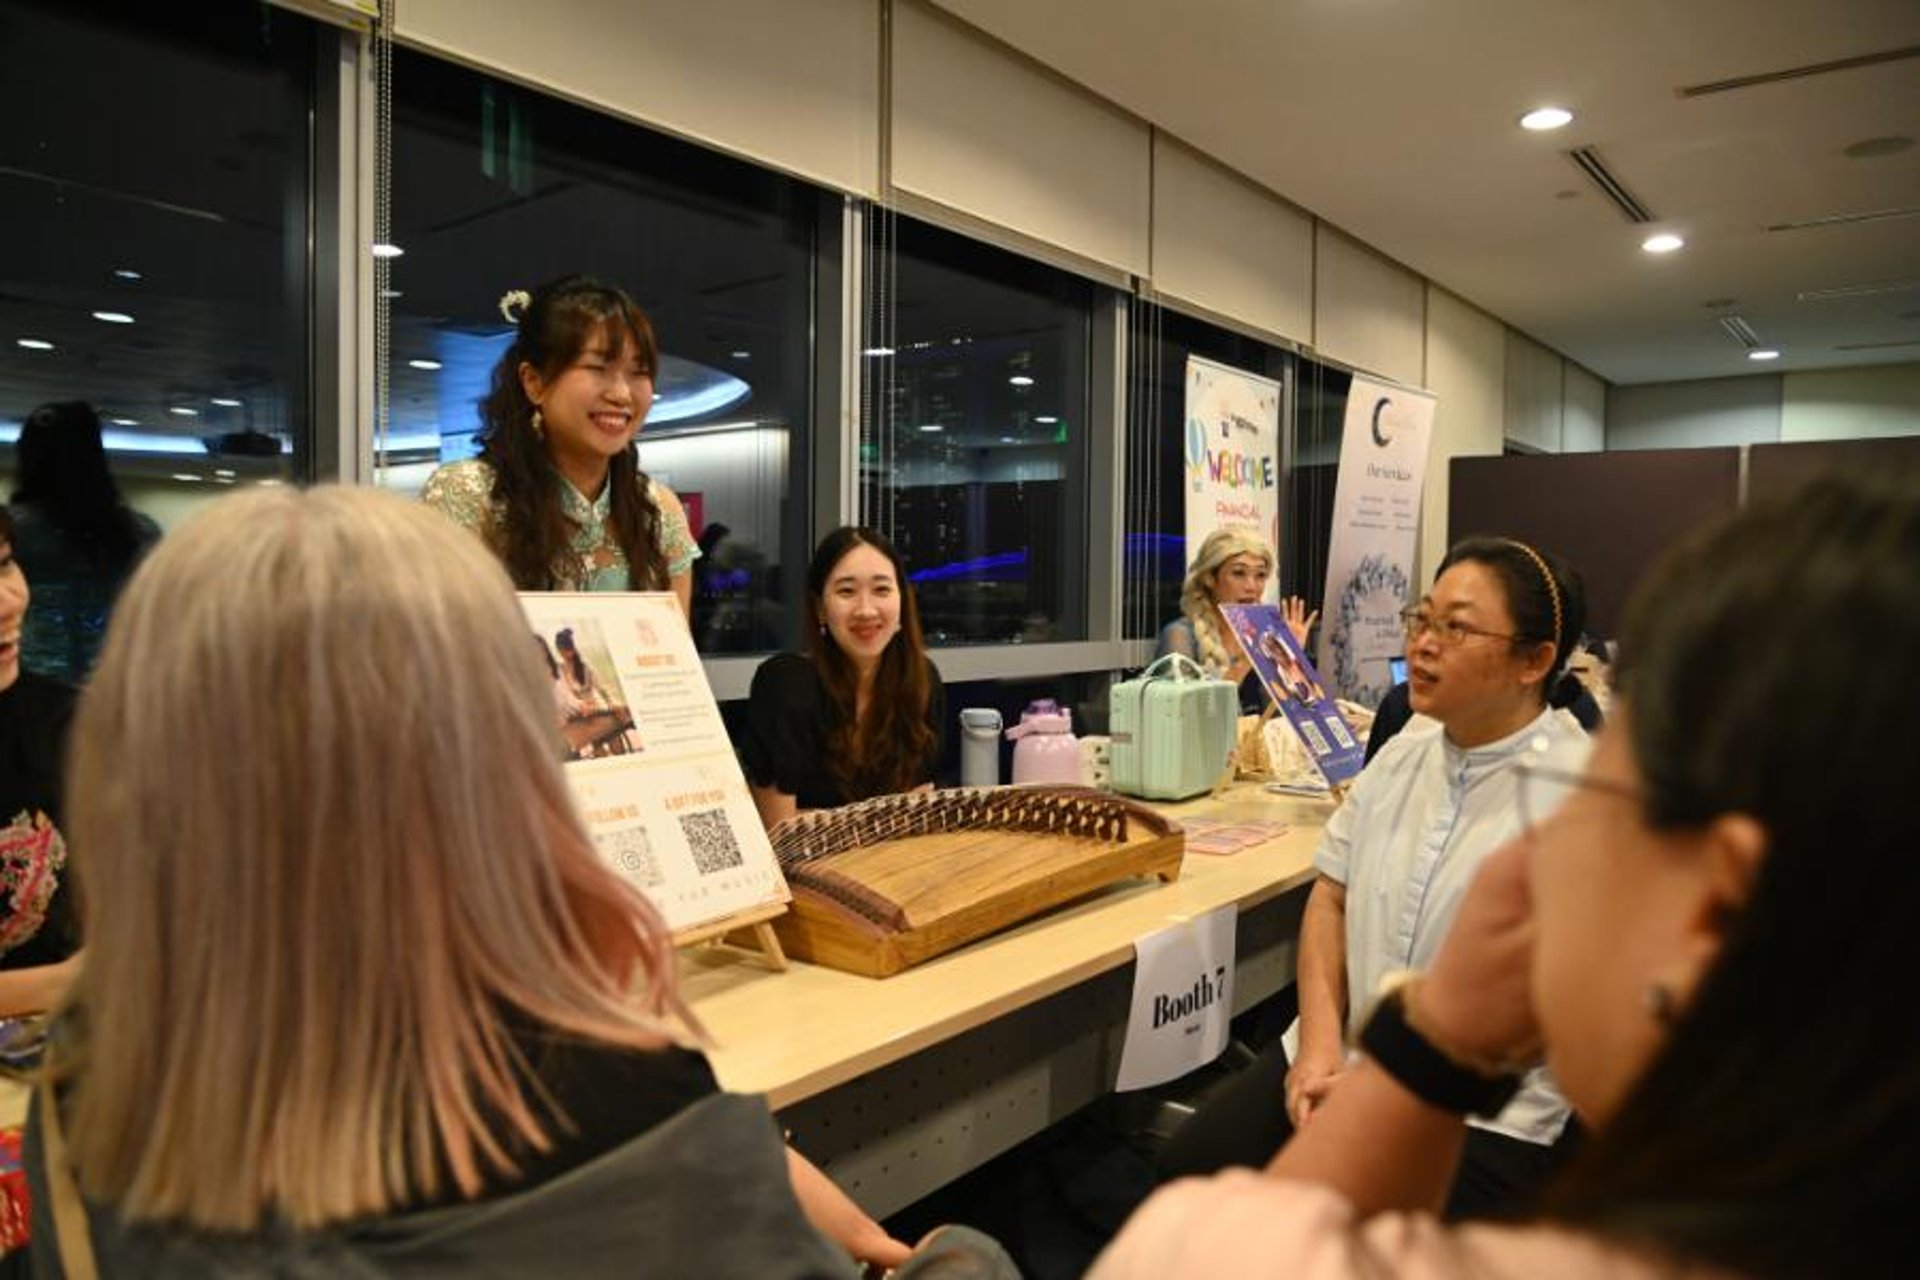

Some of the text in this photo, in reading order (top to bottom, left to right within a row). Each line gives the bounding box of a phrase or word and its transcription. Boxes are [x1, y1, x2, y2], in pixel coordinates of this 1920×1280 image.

[1207, 448, 1274, 491] WELCOME
[1153, 966, 1225, 1029] Booth 7
